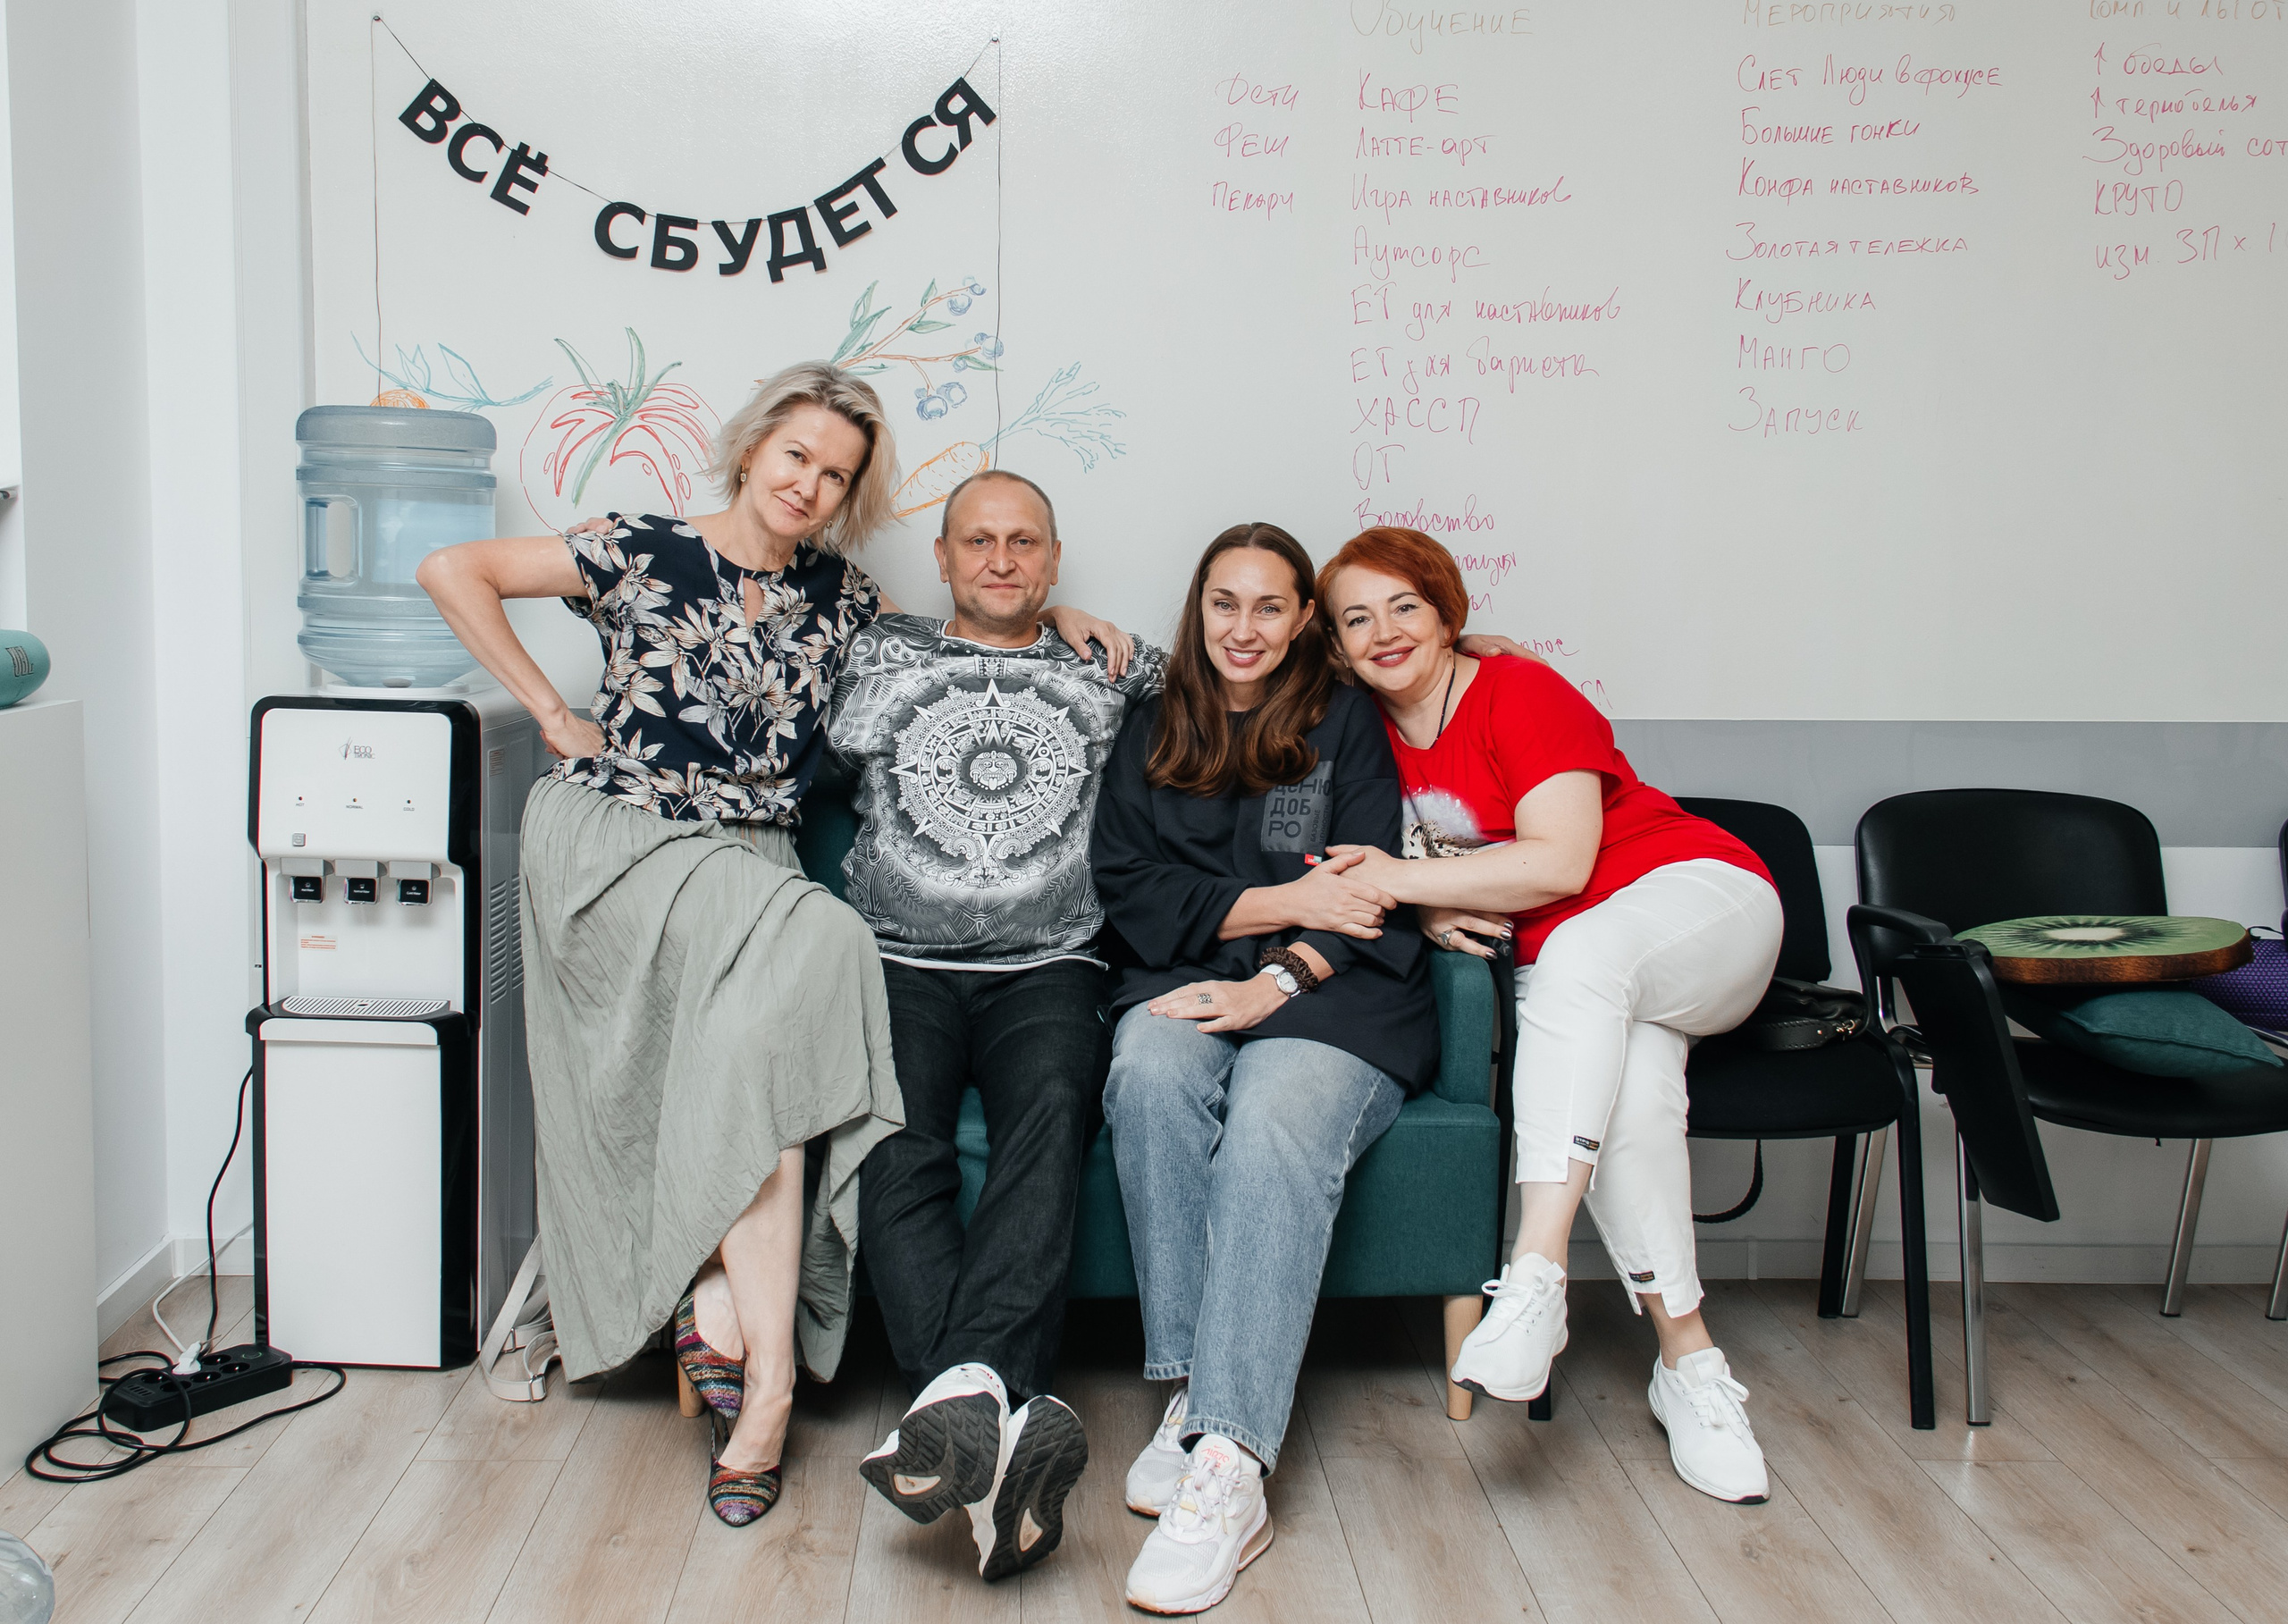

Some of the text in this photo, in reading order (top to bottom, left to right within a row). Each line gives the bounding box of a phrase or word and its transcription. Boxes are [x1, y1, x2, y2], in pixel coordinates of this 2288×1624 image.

[399, 78, 548, 215] ВСЁ
[1270, 797, 1311, 817] ДОБ
[1268, 820, 1302, 837] РО
